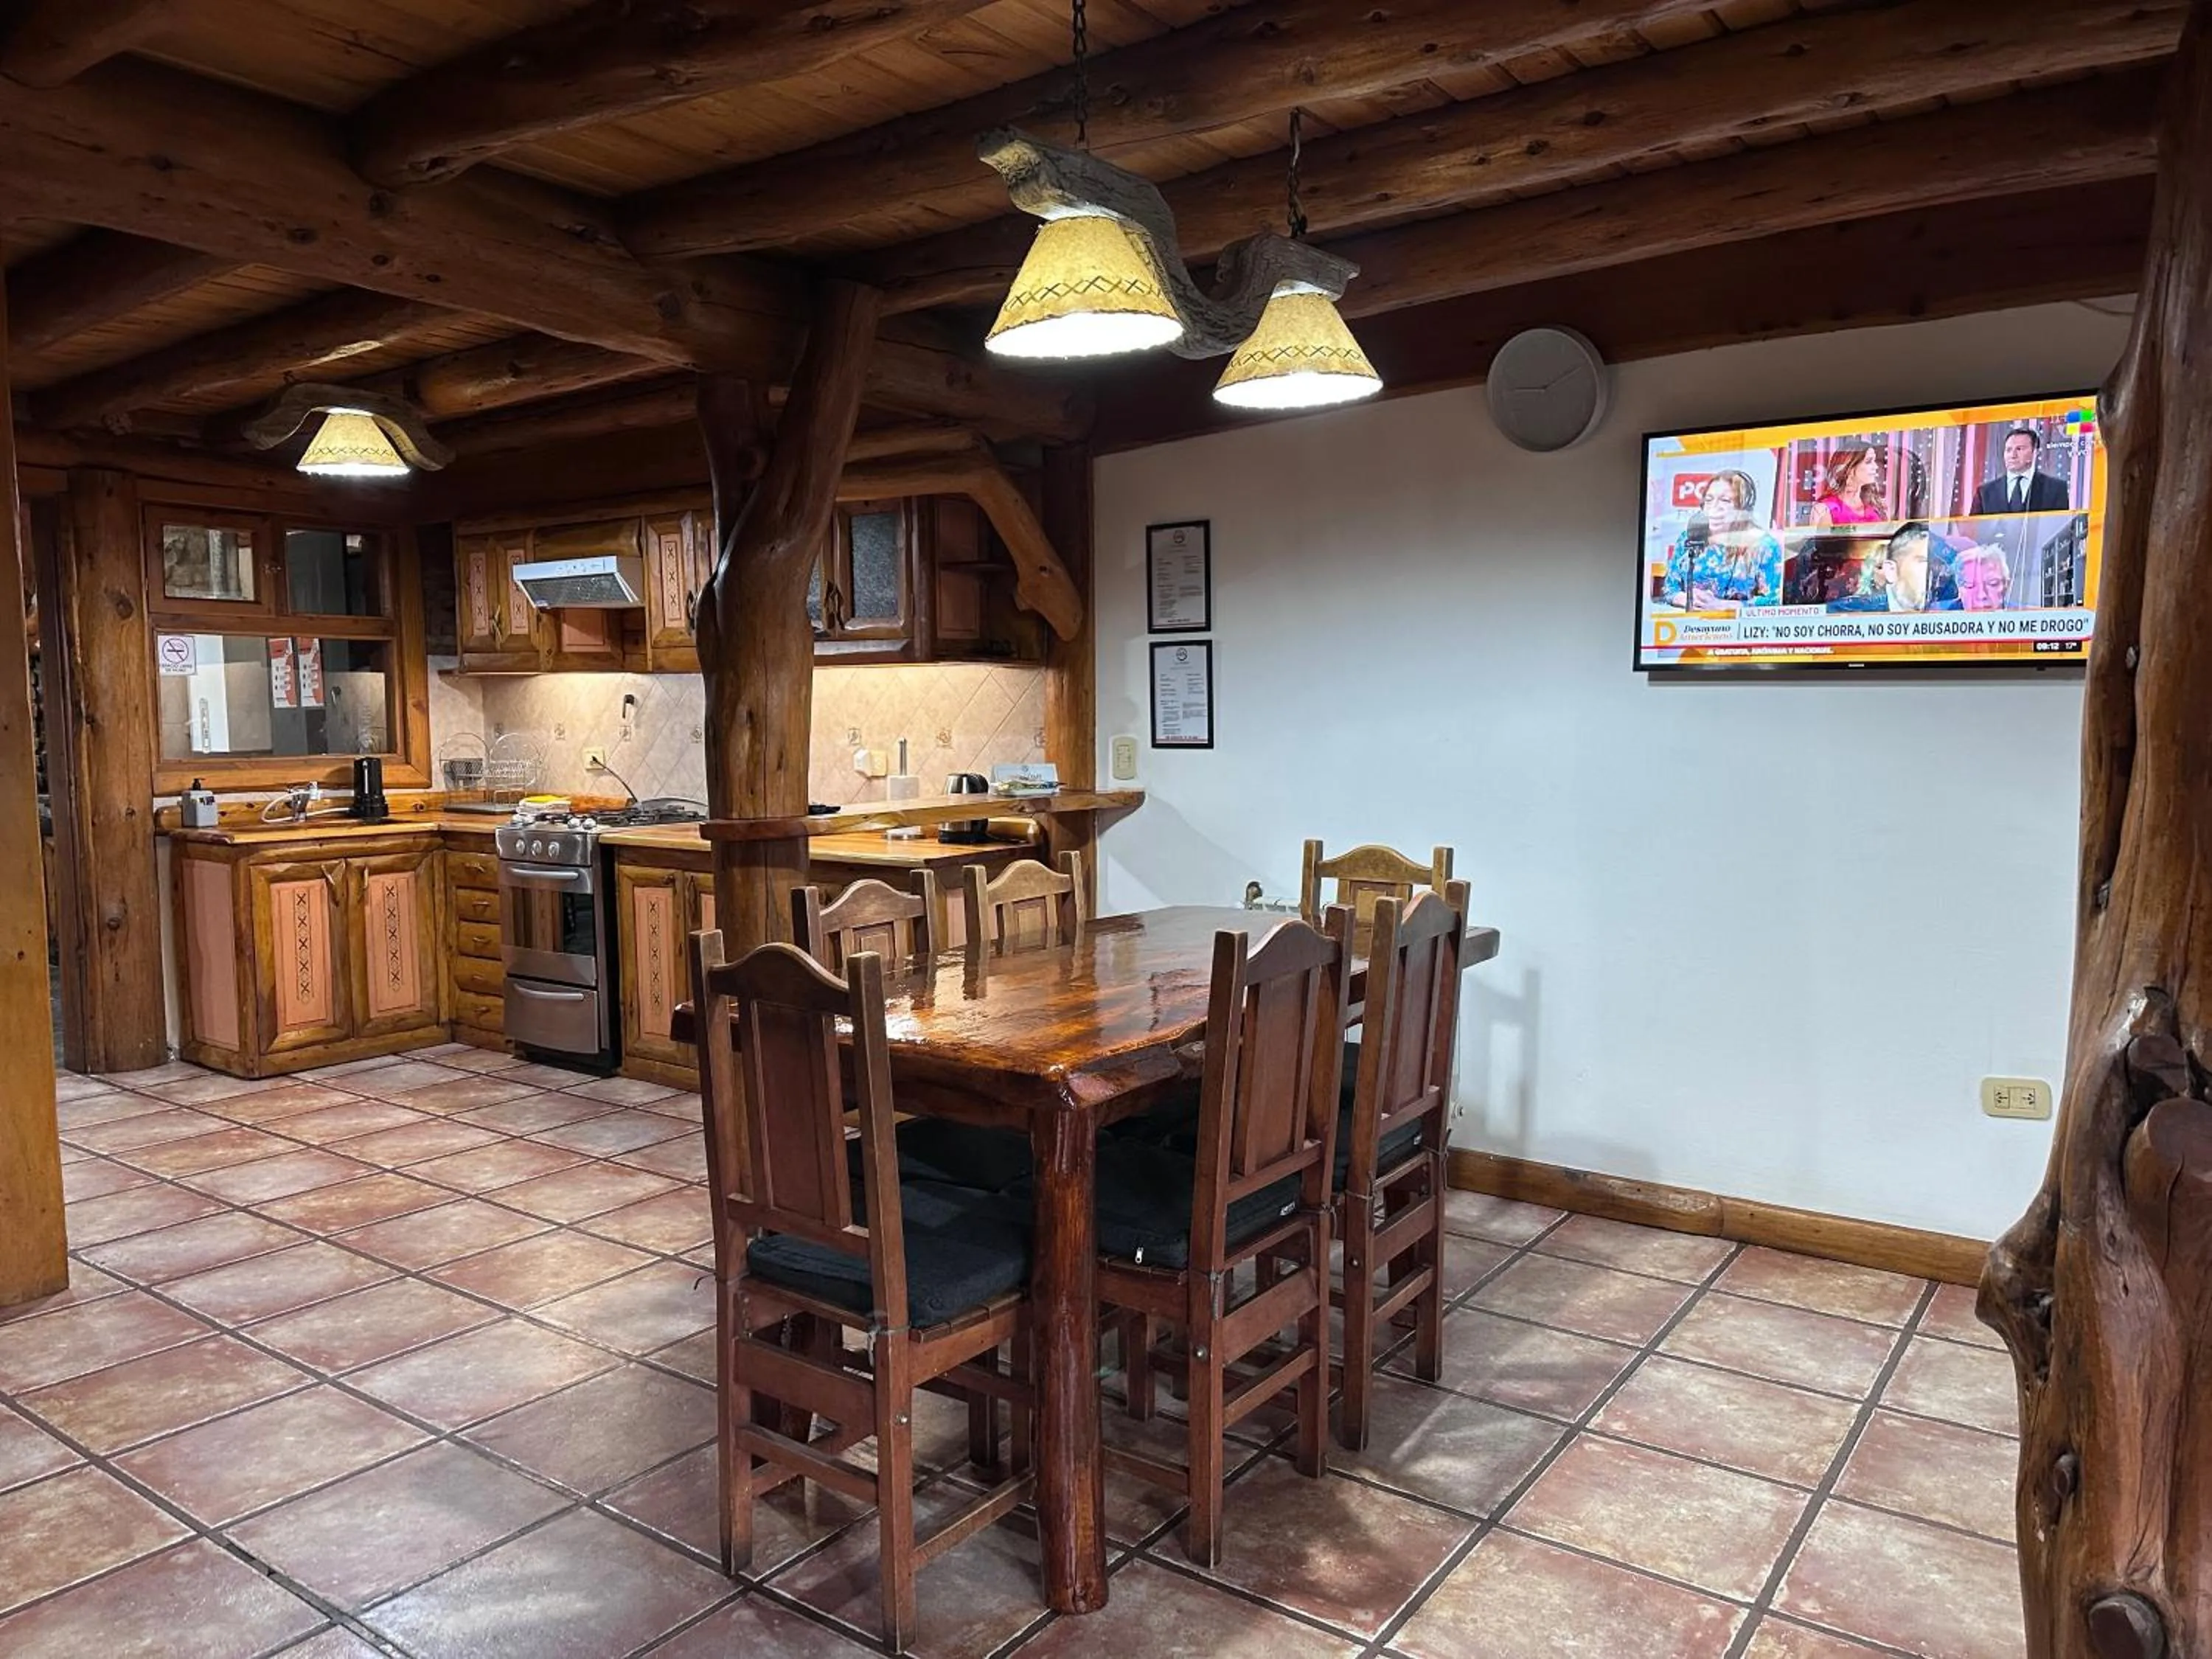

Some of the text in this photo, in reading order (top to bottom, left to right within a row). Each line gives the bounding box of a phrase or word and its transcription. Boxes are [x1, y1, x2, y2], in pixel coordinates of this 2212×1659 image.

[1778, 607, 1820, 616] MOMENTO
[1744, 626, 1769, 639] LIZY:
[1794, 625, 1815, 638] SOY
[1818, 624, 1865, 638] CHORRA,
[1868, 623, 1884, 636] NO
[1887, 622, 1910, 636] SOY
[1912, 621, 1984, 635] ABUSADORA
[1987, 620, 1995, 633] Y
[1997, 620, 2016, 633] NO
[2019, 619, 2037, 633] ME
[2040, 618, 2089, 633] DROGO"
